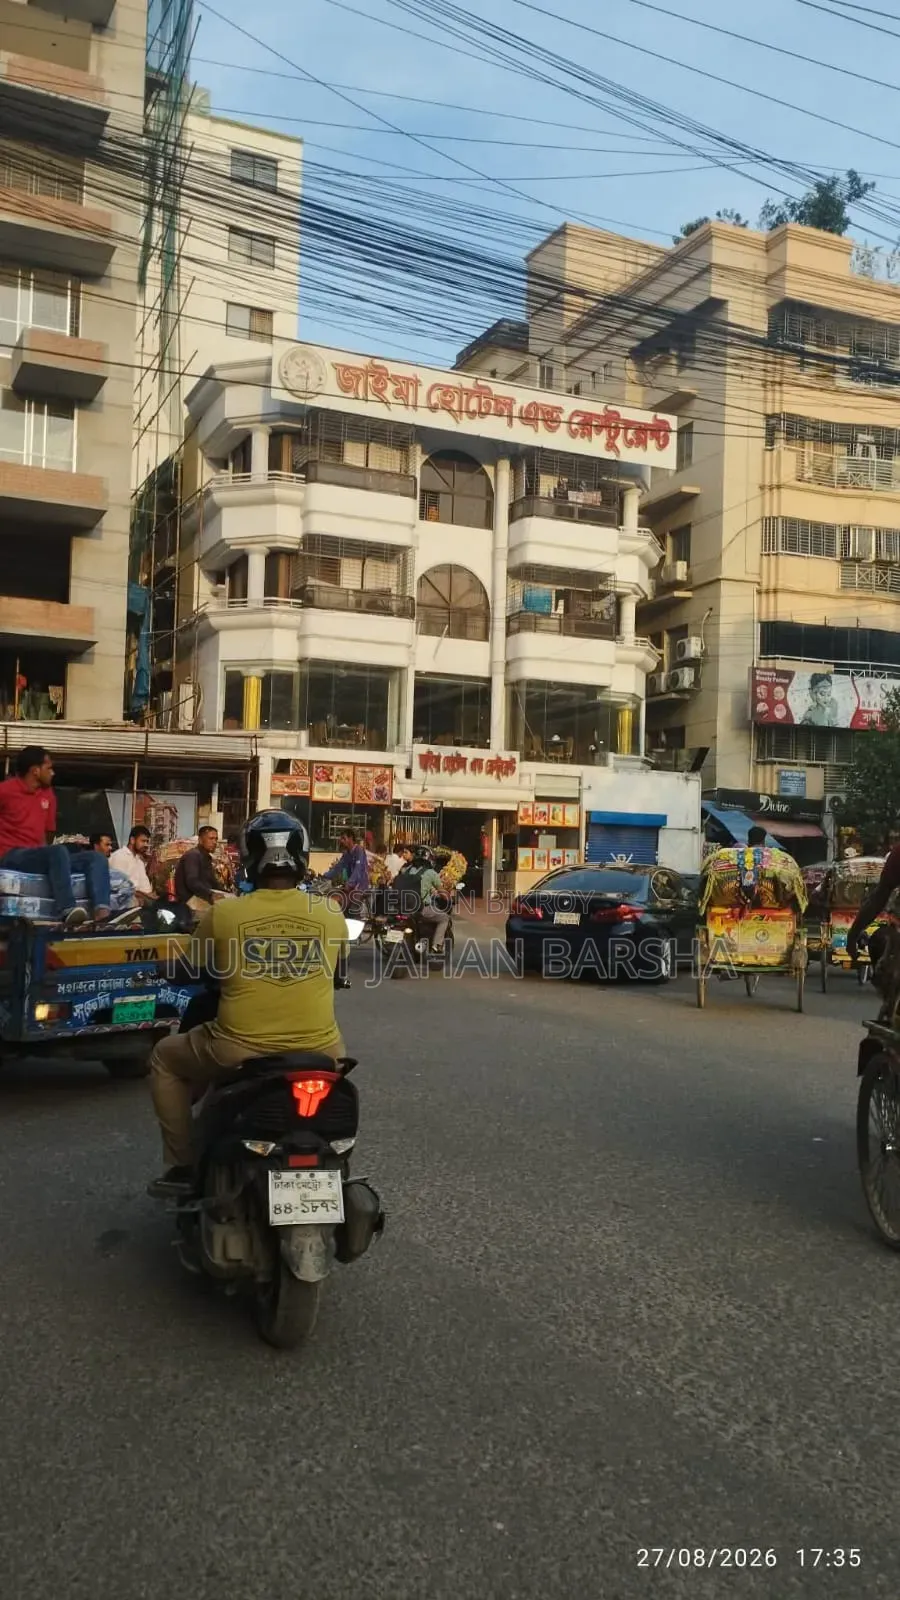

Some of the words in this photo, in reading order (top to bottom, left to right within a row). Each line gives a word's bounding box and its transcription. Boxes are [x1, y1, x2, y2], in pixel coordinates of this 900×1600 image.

[331, 359, 422, 411] জাইমা
[426, 378, 516, 428] হোটেল
[125, 948, 158, 961] TATA
[275, 1181, 295, 1189] ঢাকা
[296, 1179, 321, 1191] মেট্রো
